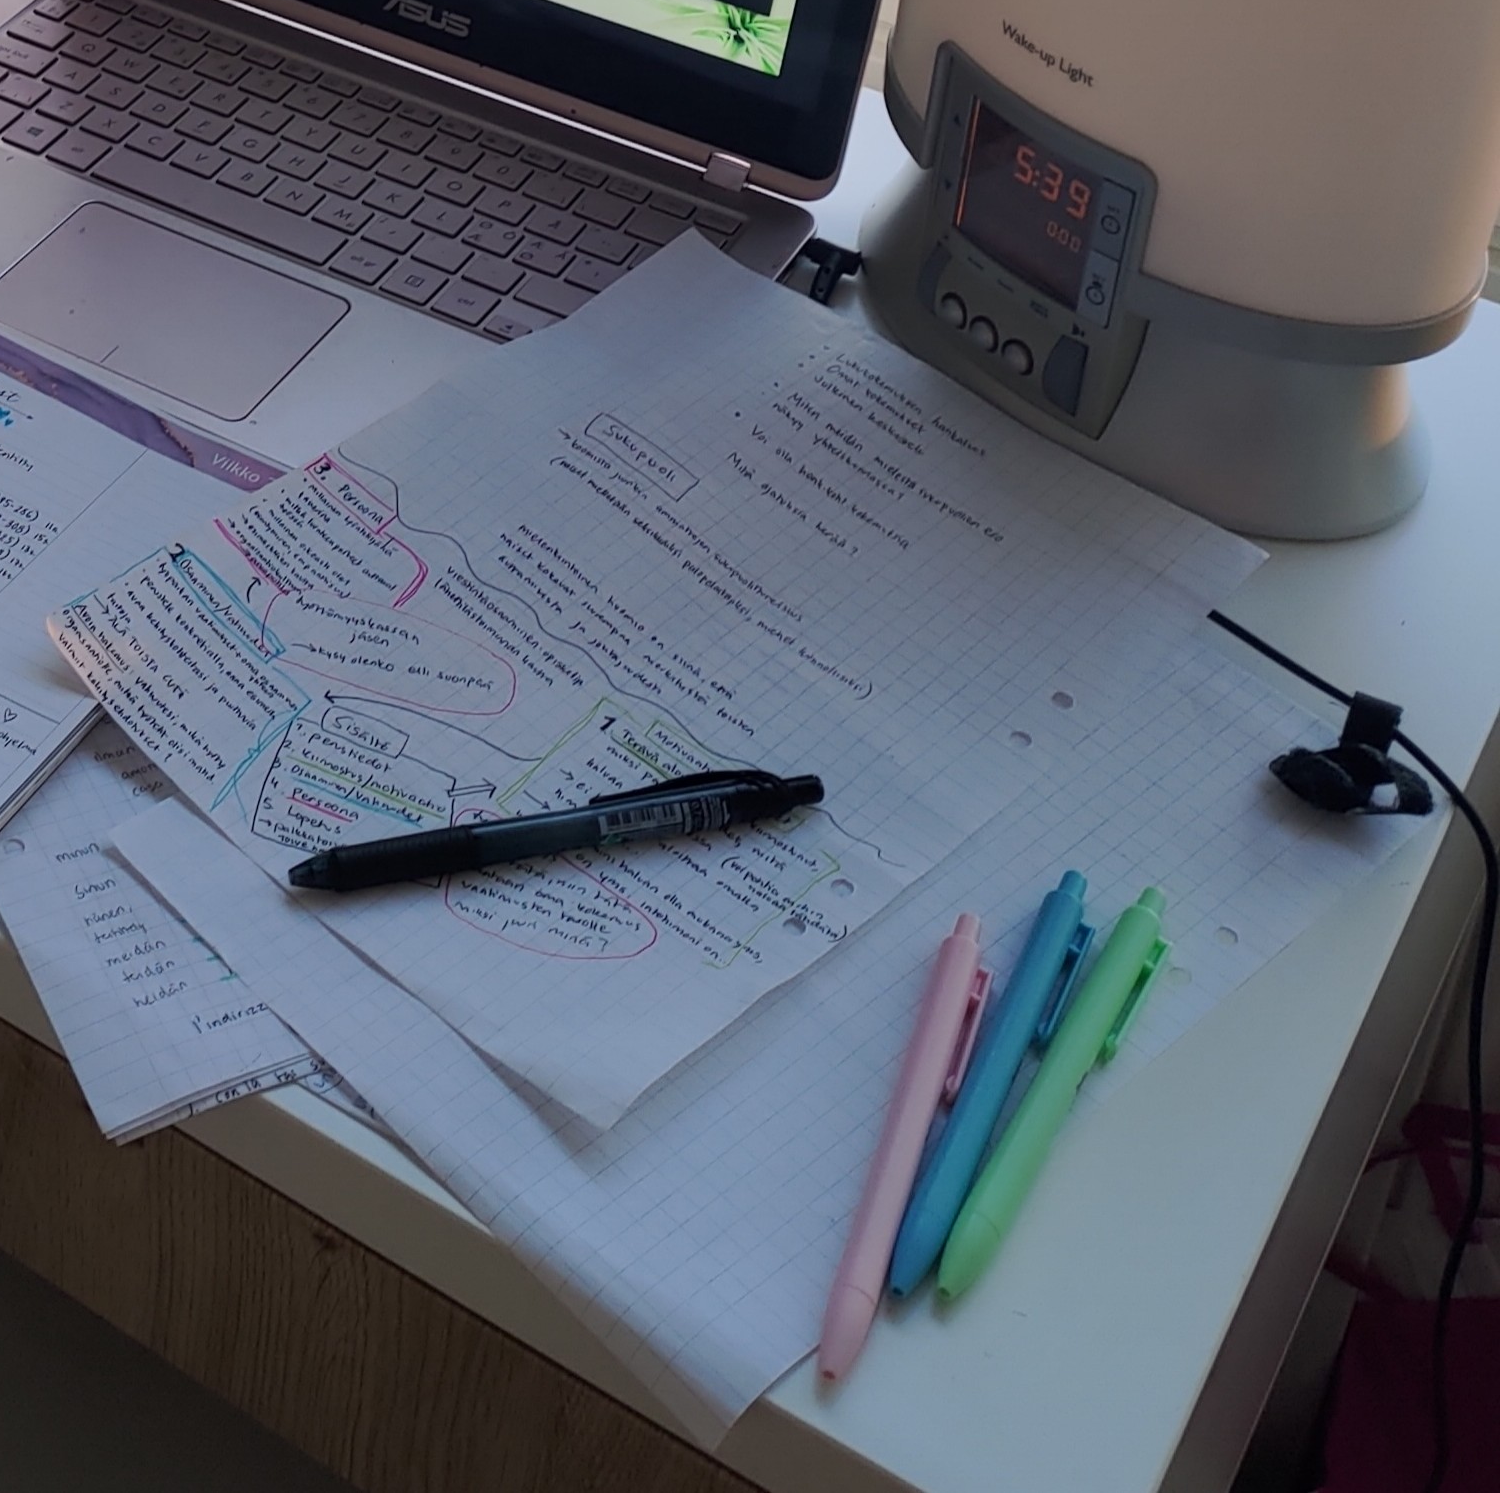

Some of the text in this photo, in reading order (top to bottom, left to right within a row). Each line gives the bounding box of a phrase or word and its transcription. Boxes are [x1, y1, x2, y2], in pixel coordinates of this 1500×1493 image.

[1002, 19, 1094, 87] Wake-up Light
[1014, 144, 1090, 220] 5:39
[212, 452, 260, 483] Viikko
